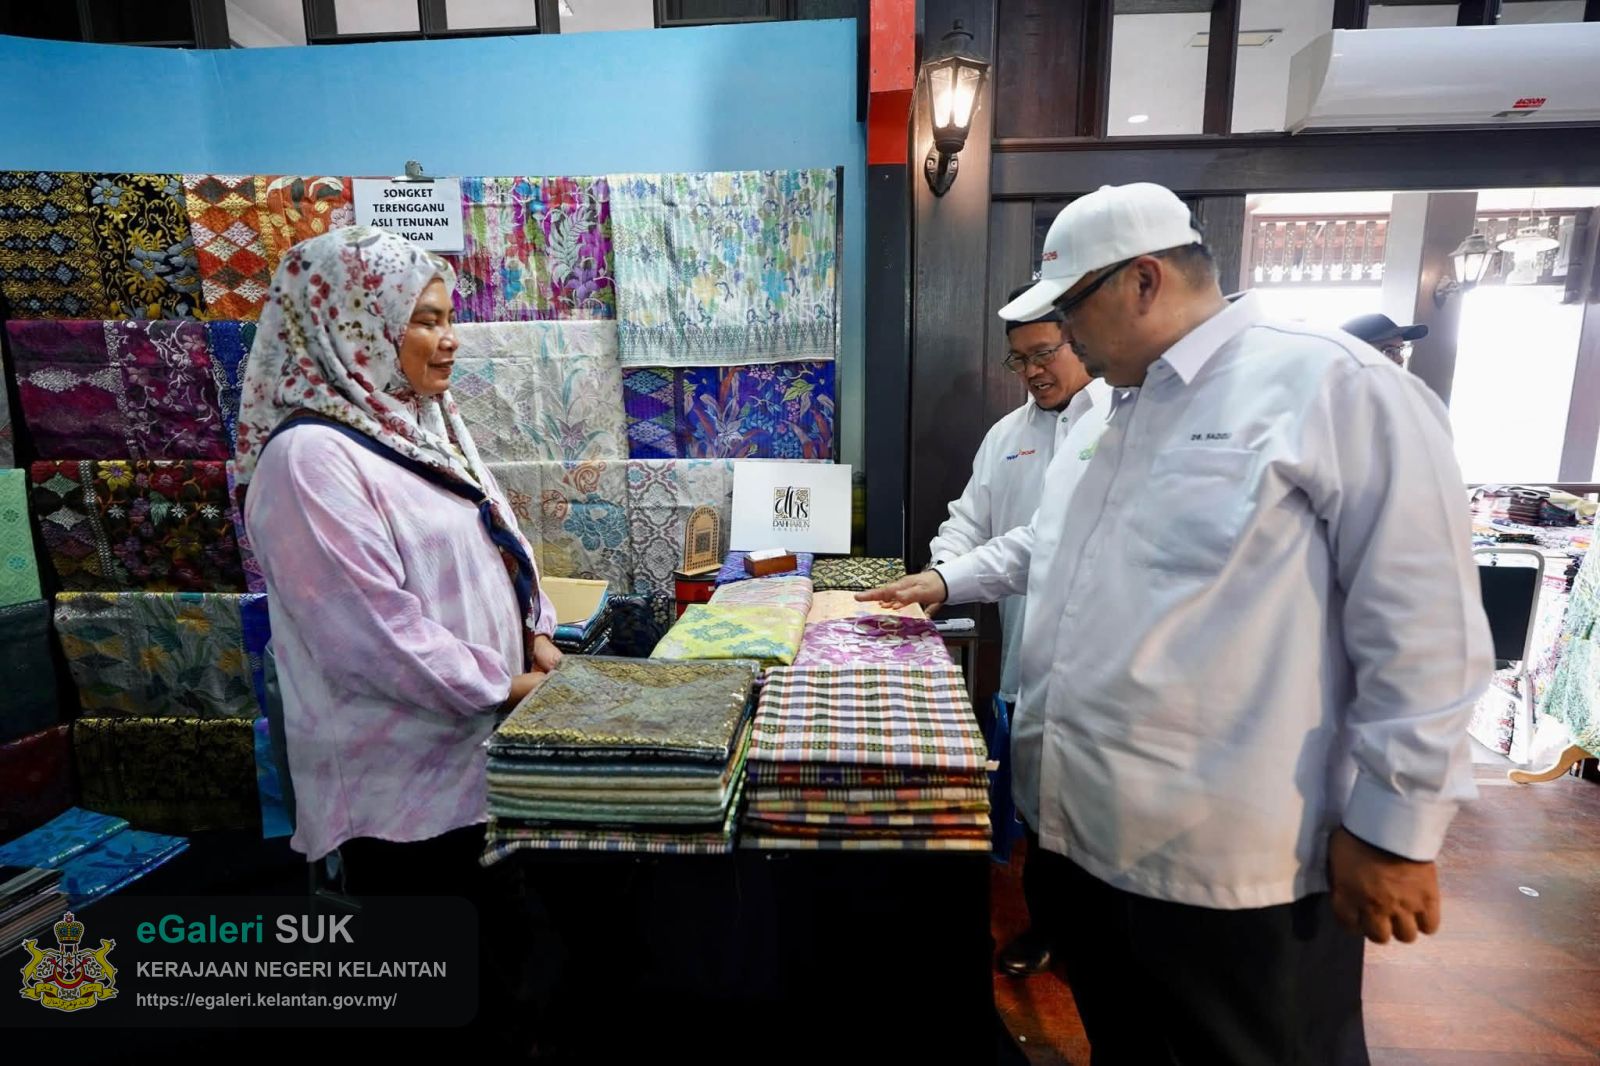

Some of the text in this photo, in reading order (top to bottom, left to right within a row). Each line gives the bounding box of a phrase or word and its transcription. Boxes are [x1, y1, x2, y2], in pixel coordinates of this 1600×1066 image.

[383, 188, 433, 198] SONGKET
[372, 203, 445, 213] TERENGGANU
[371, 217, 449, 227] ASLI TENUNAN
[396, 232, 434, 241] NGAN
